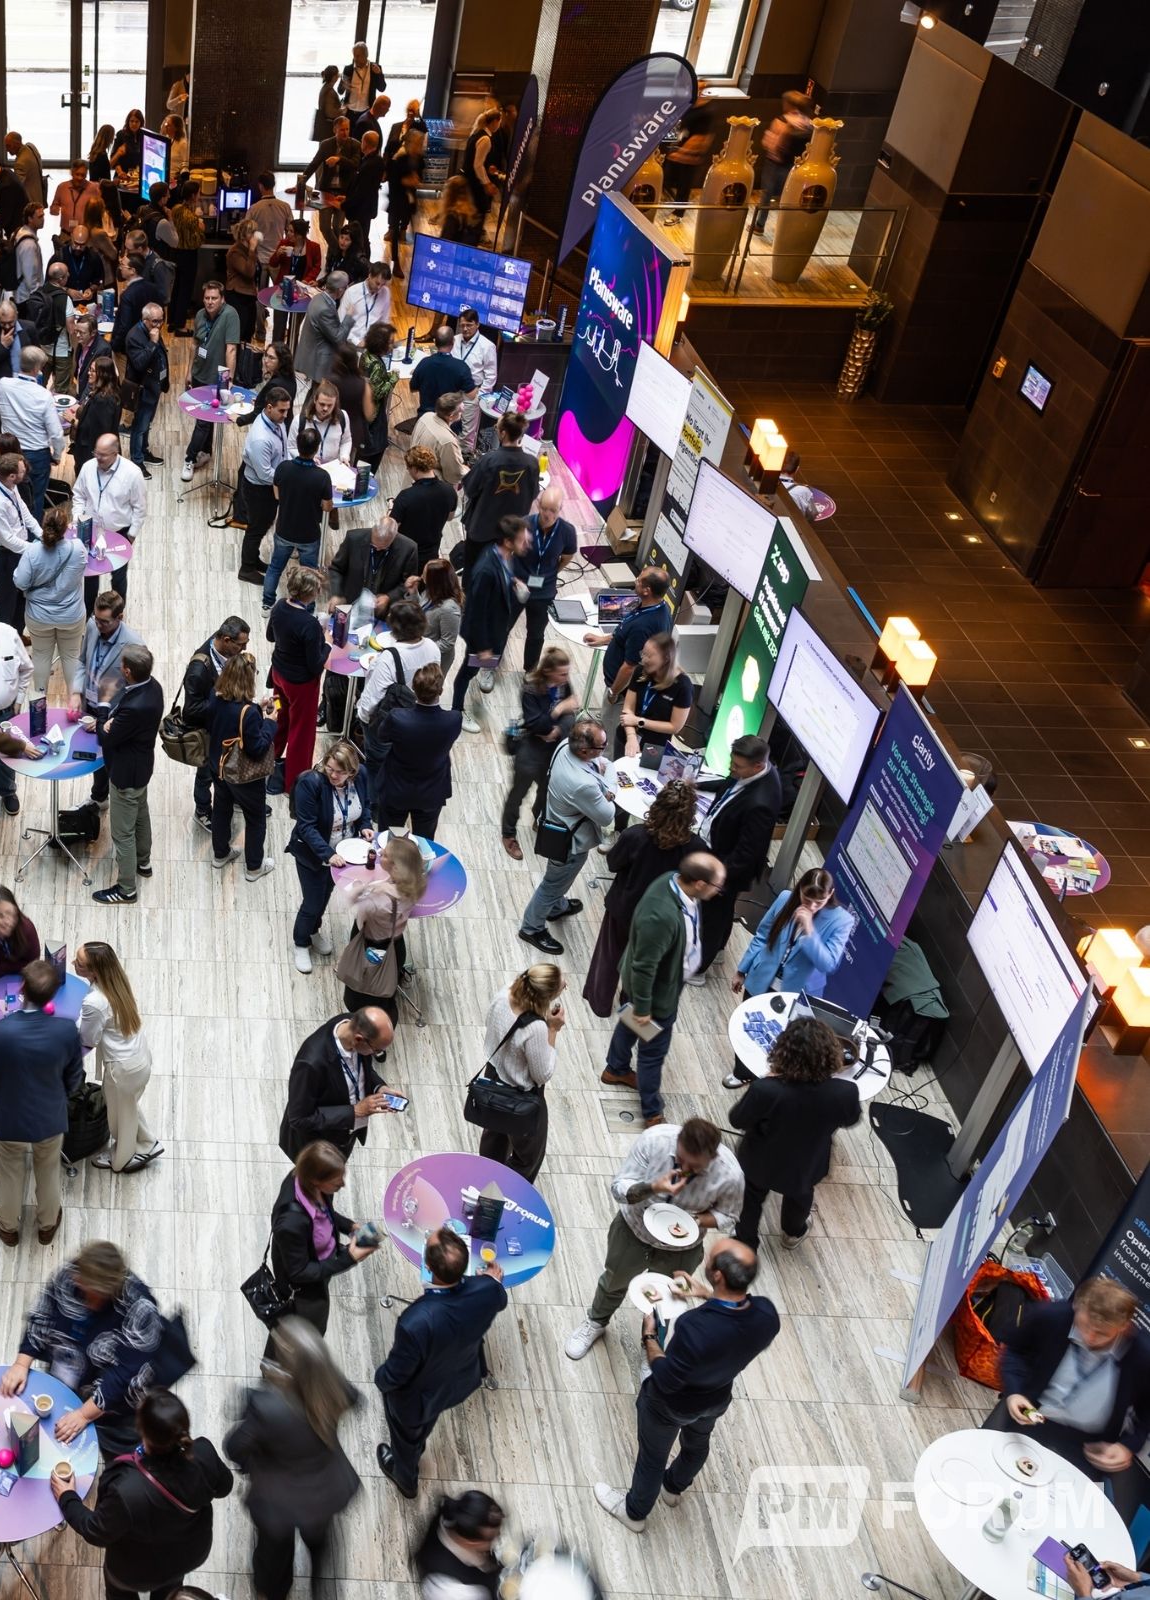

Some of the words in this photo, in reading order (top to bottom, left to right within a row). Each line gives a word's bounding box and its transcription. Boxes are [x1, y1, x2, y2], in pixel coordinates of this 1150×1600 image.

[581, 100, 677, 207] Planisware
[589, 267, 633, 331] Planisware
[912, 734, 936, 771] clarity
[887, 757, 898, 775] zur
[896, 769, 930, 826] Umsetzung!
[891, 740, 903, 764] Von
[901, 759, 912, 777] der
[910, 772, 935, 817] Strategie
[514, 1203, 550, 1229] FORUM
[1134, 1217, 1150, 1239] sfin
[1120, 1239, 1140, 1264] from
